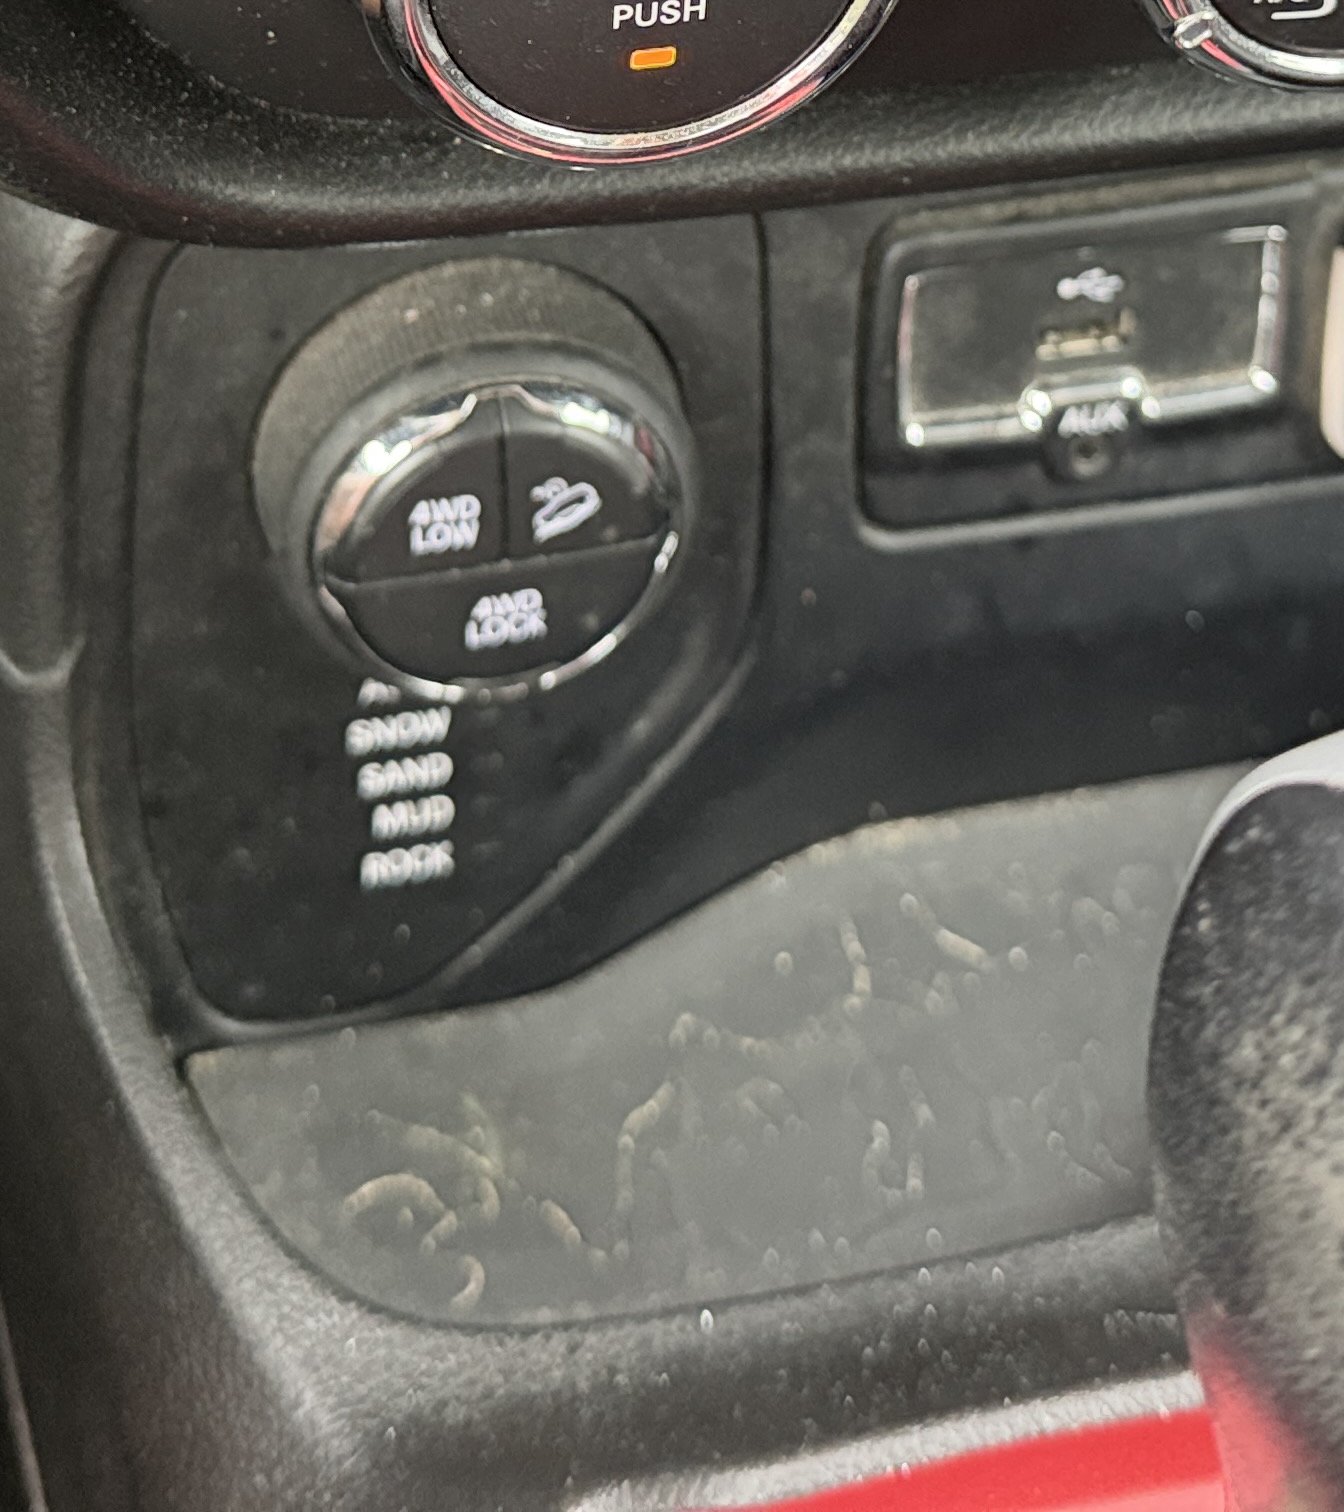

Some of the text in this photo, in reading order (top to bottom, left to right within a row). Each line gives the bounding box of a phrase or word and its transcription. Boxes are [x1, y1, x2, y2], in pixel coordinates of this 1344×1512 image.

[408, 494, 481, 526] 4WD
[409, 520, 480, 556] LOW
[470, 588, 543, 621] 4WD
[464, 610, 548, 651] LOCK
[345, 705, 452, 756] SNOW
[357, 752, 454, 800] SAND
[371, 795, 456, 839] MUD
[360, 840, 454, 888] ROCK
